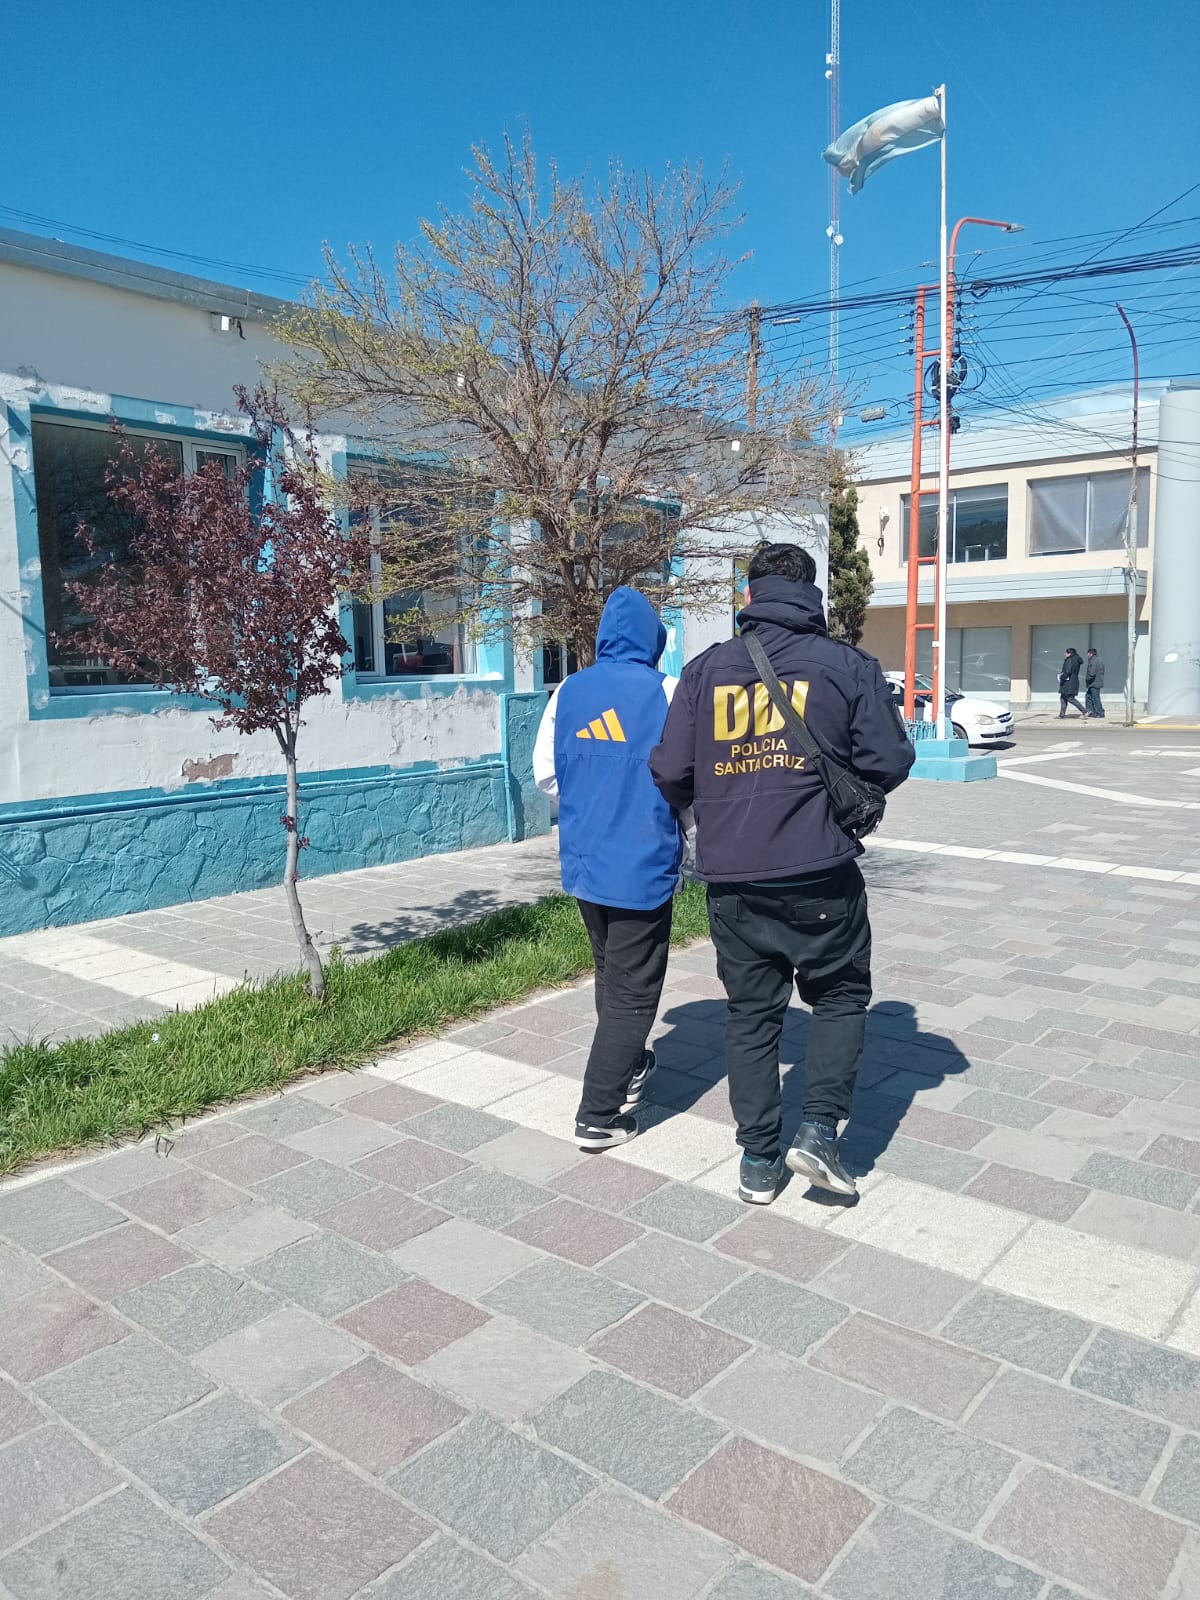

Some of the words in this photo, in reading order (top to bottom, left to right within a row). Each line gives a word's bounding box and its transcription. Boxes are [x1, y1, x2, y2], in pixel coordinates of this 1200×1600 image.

[731, 738, 788, 758] POLCIA
[714, 758, 760, 776] SANTA
[763, 754, 805, 769] CRUZ
